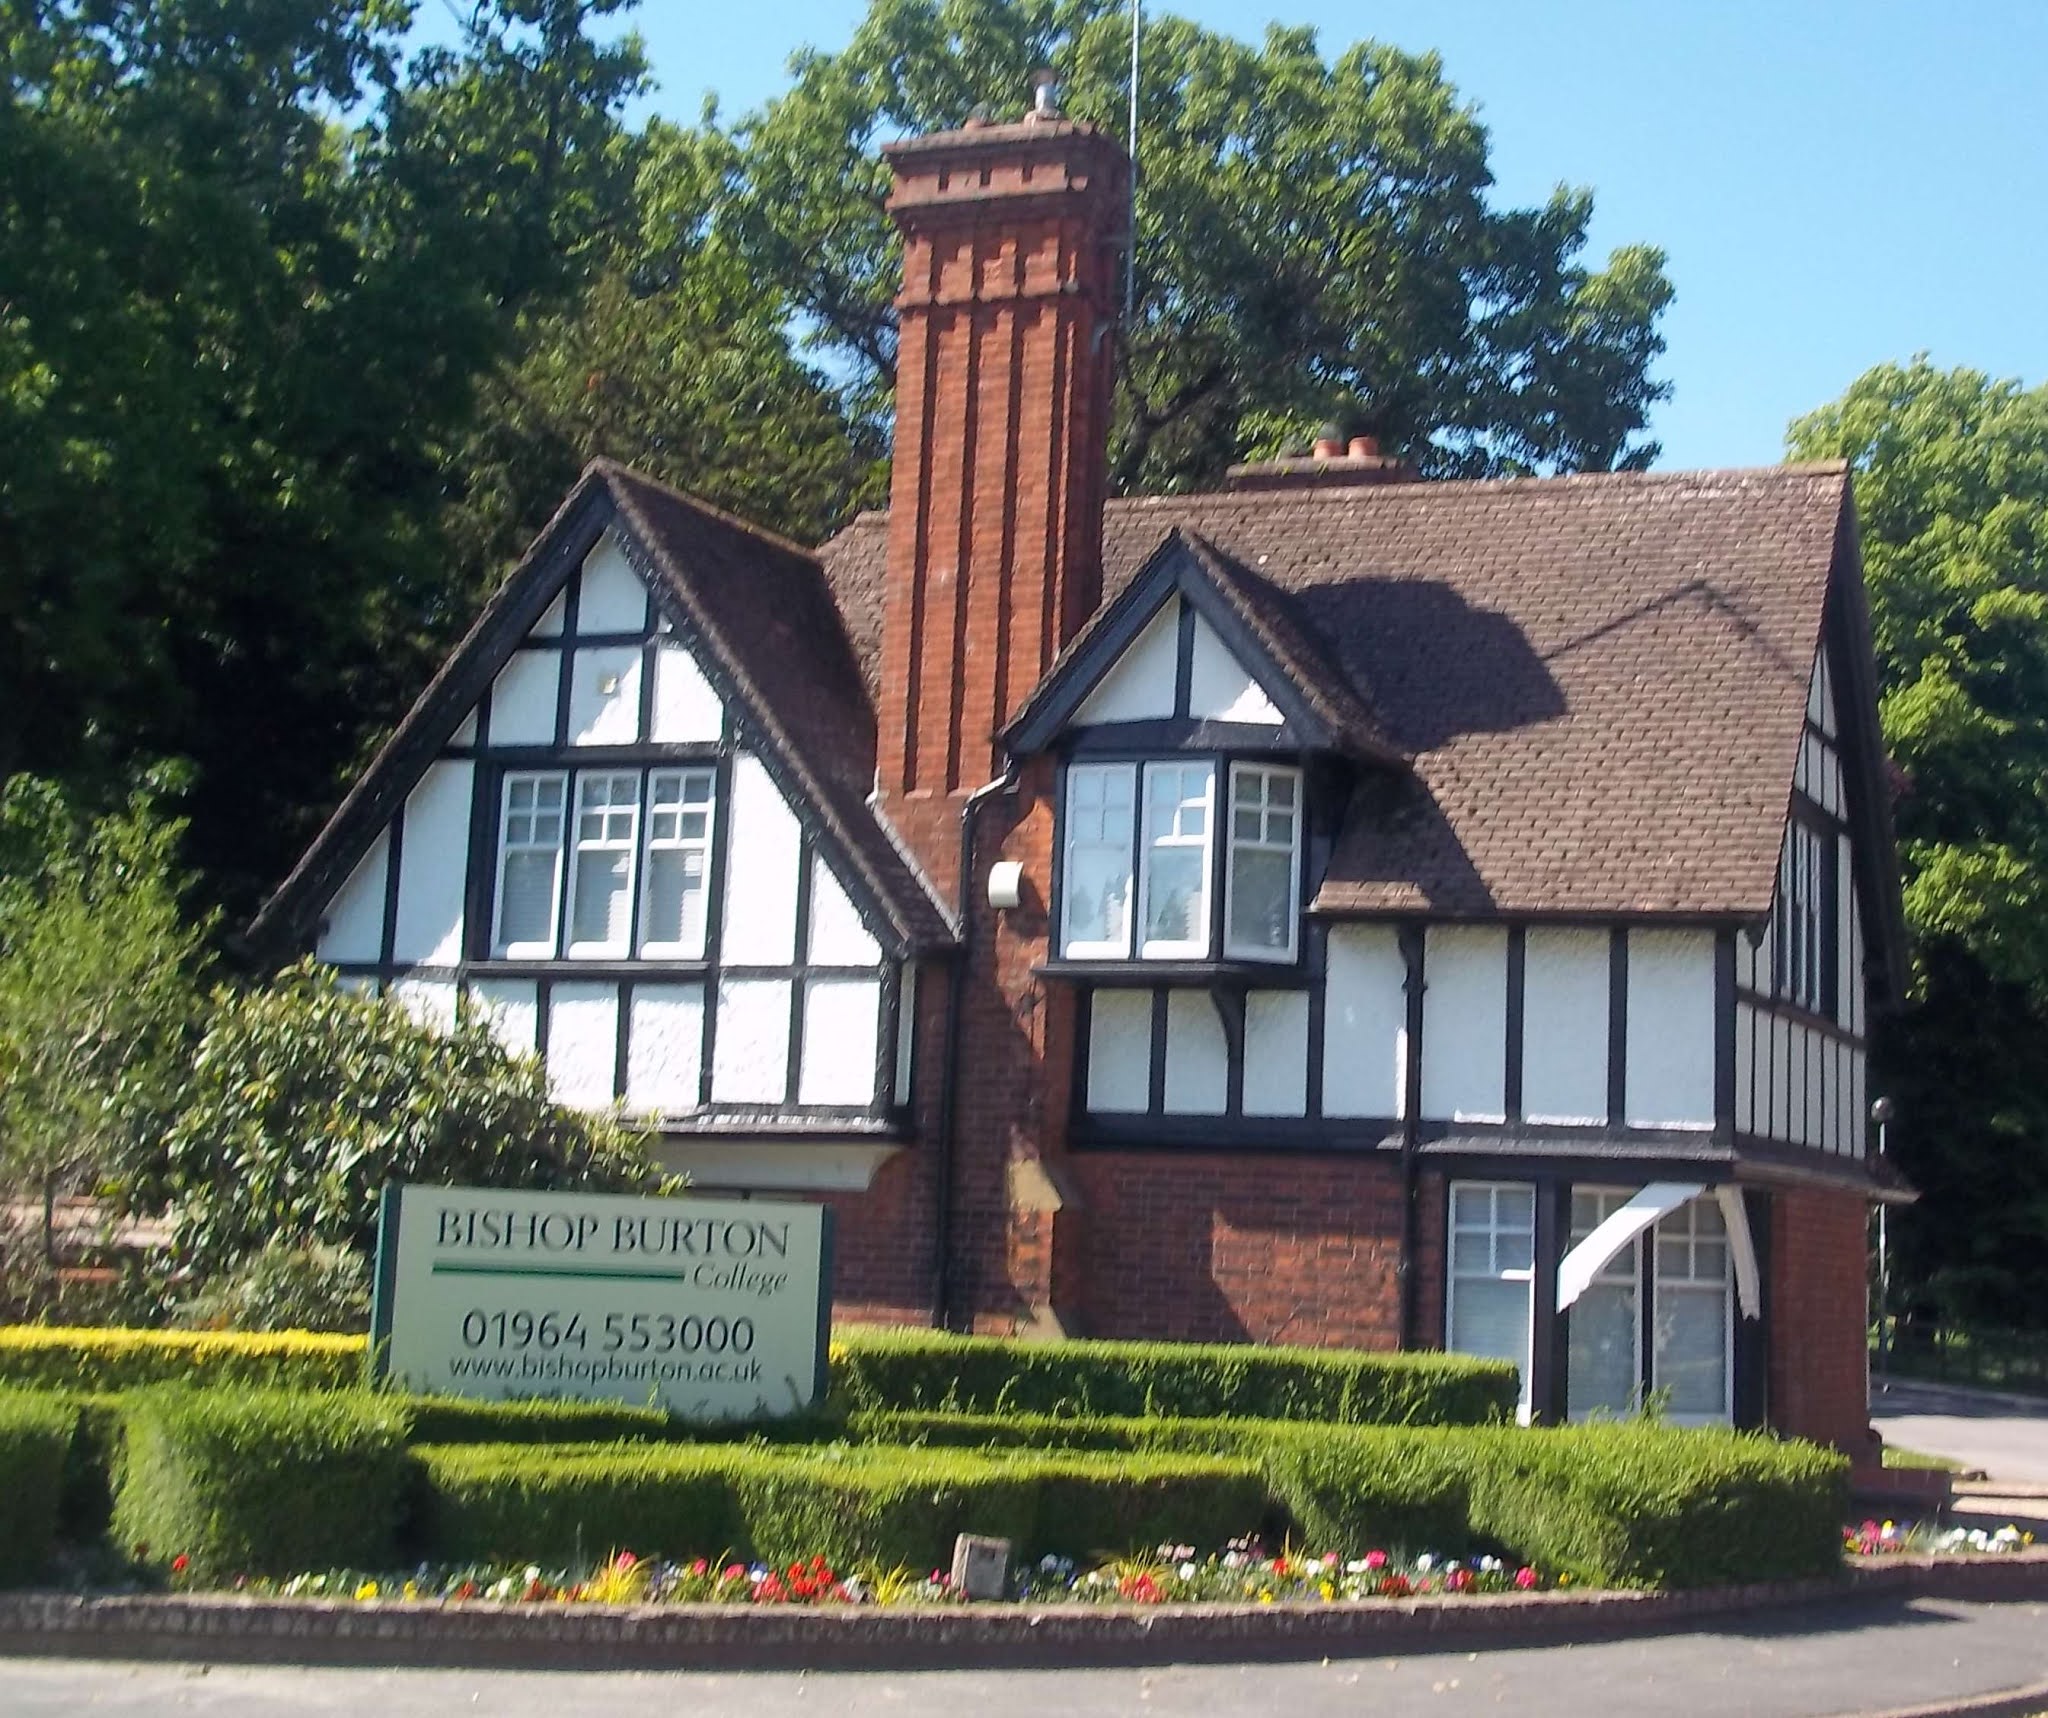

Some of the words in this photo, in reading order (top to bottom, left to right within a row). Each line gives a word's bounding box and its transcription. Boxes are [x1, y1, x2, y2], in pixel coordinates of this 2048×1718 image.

[437, 1208, 598, 1251] BISHOP
[612, 1215, 790, 1258] BURTON
[693, 1262, 789, 1297] College
[462, 1309, 587, 1351] 01964
[602, 1313, 755, 1354] 553000
[450, 1354, 763, 1386] www.bishopburton.ac.uk
